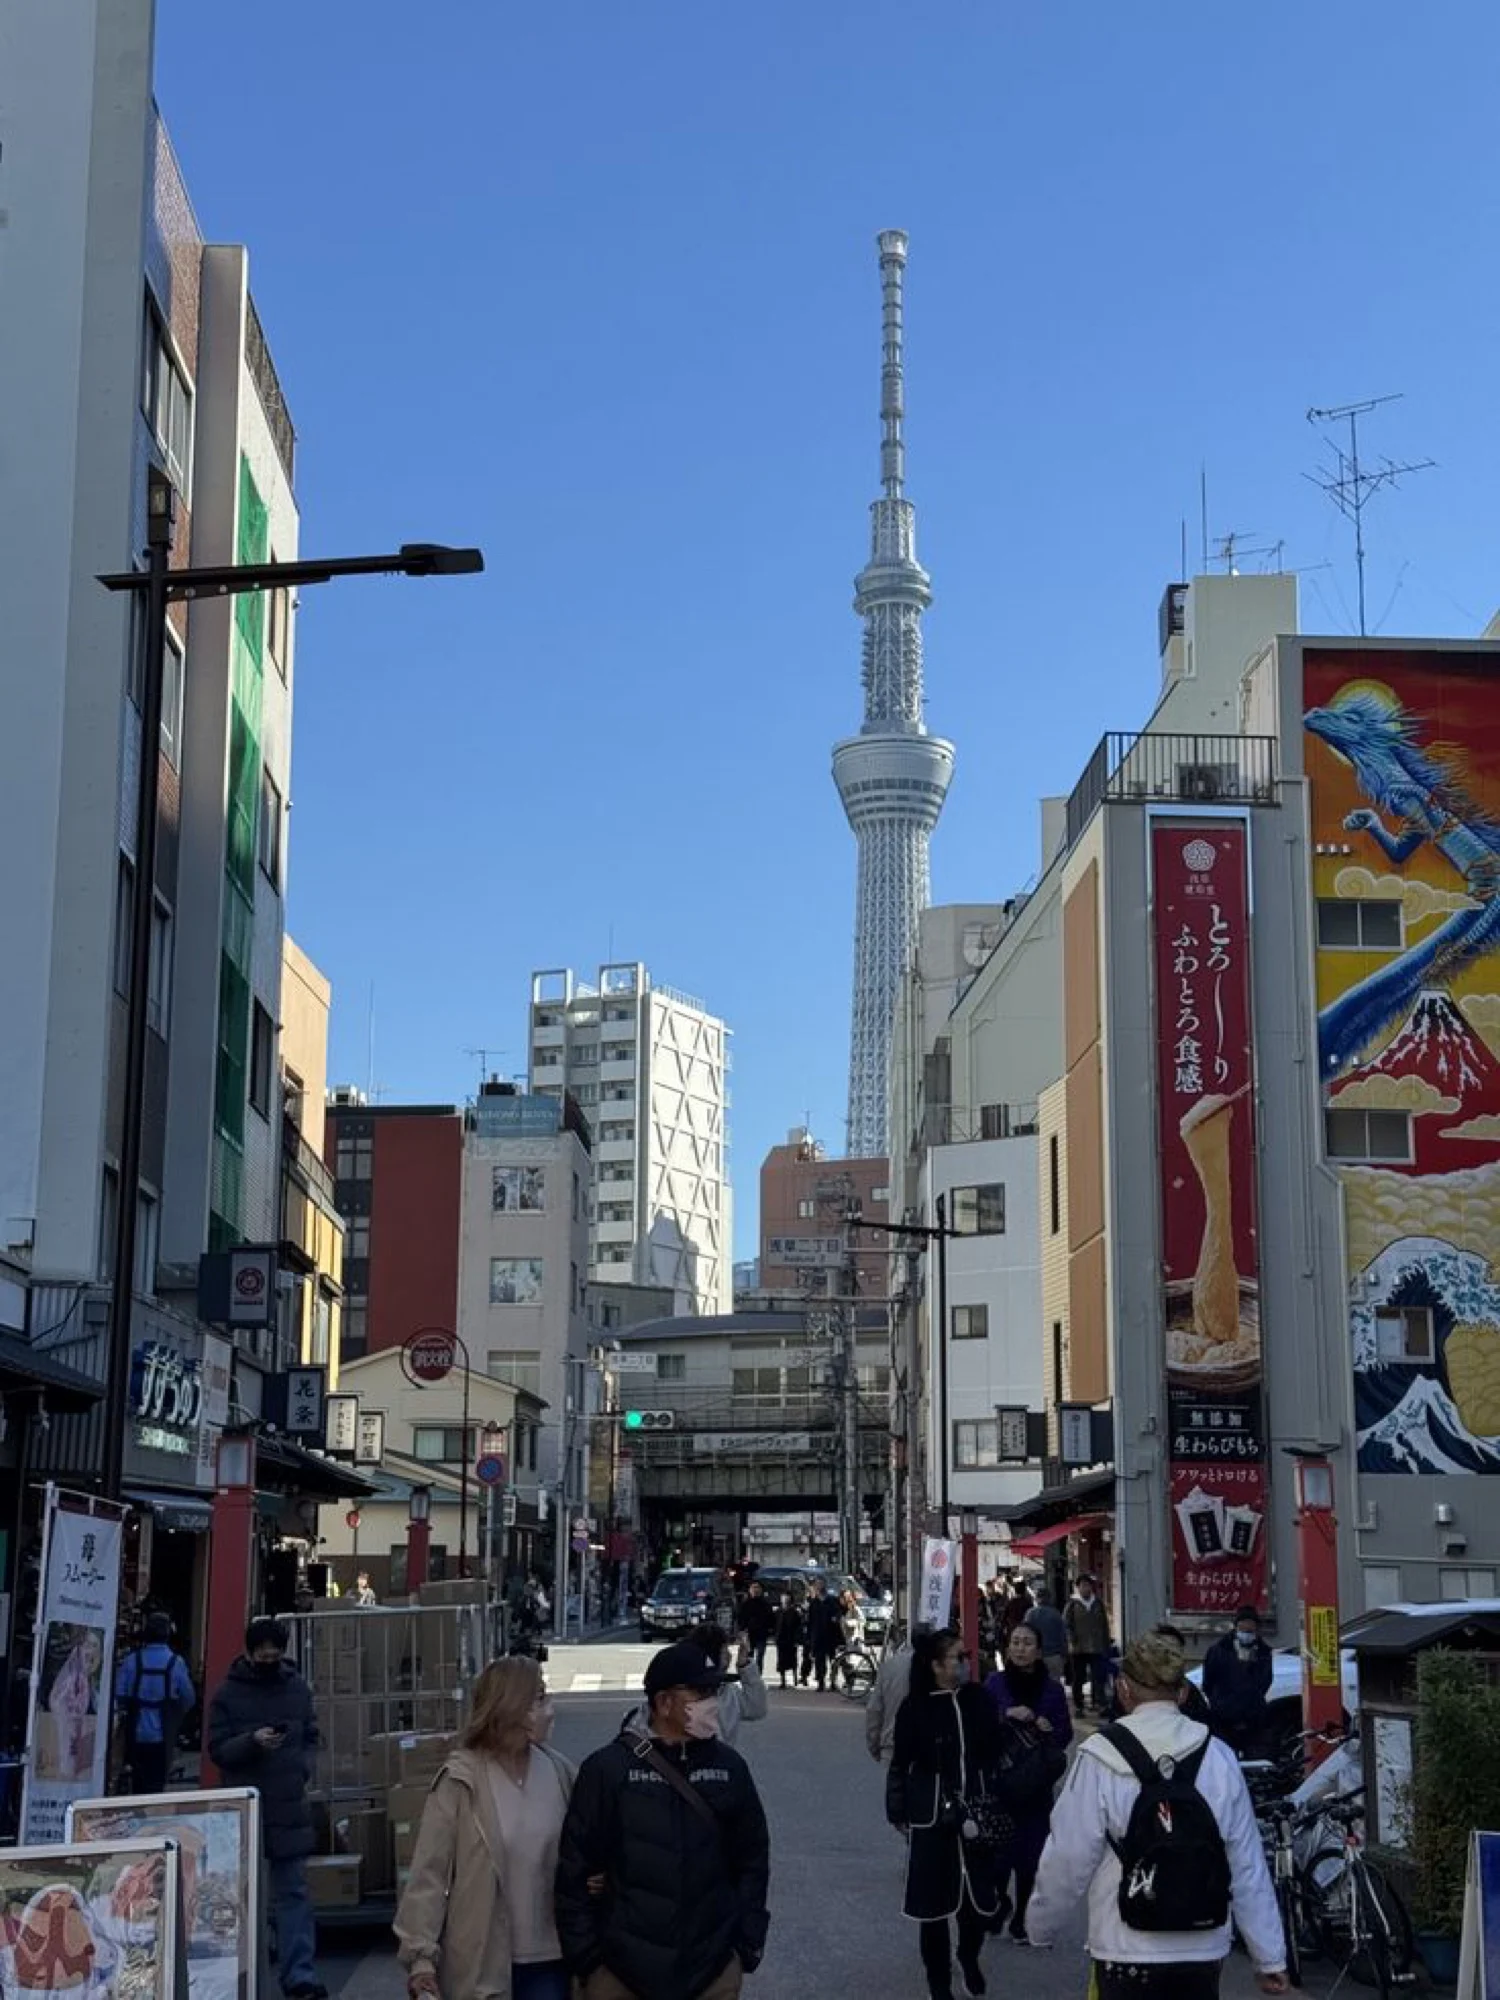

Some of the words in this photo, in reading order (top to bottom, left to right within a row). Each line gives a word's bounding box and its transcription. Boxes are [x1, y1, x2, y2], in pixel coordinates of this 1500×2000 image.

[1172, 923, 1203, 1093] ふわとろ食感
[1174, 1435, 1259, 1455] 生わらびもち
[63, 1563, 106, 1586] スムージー
[1186, 1571, 1252, 1587] 生わらびもち
[1200, 1590, 1240, 1604] ドリンク
